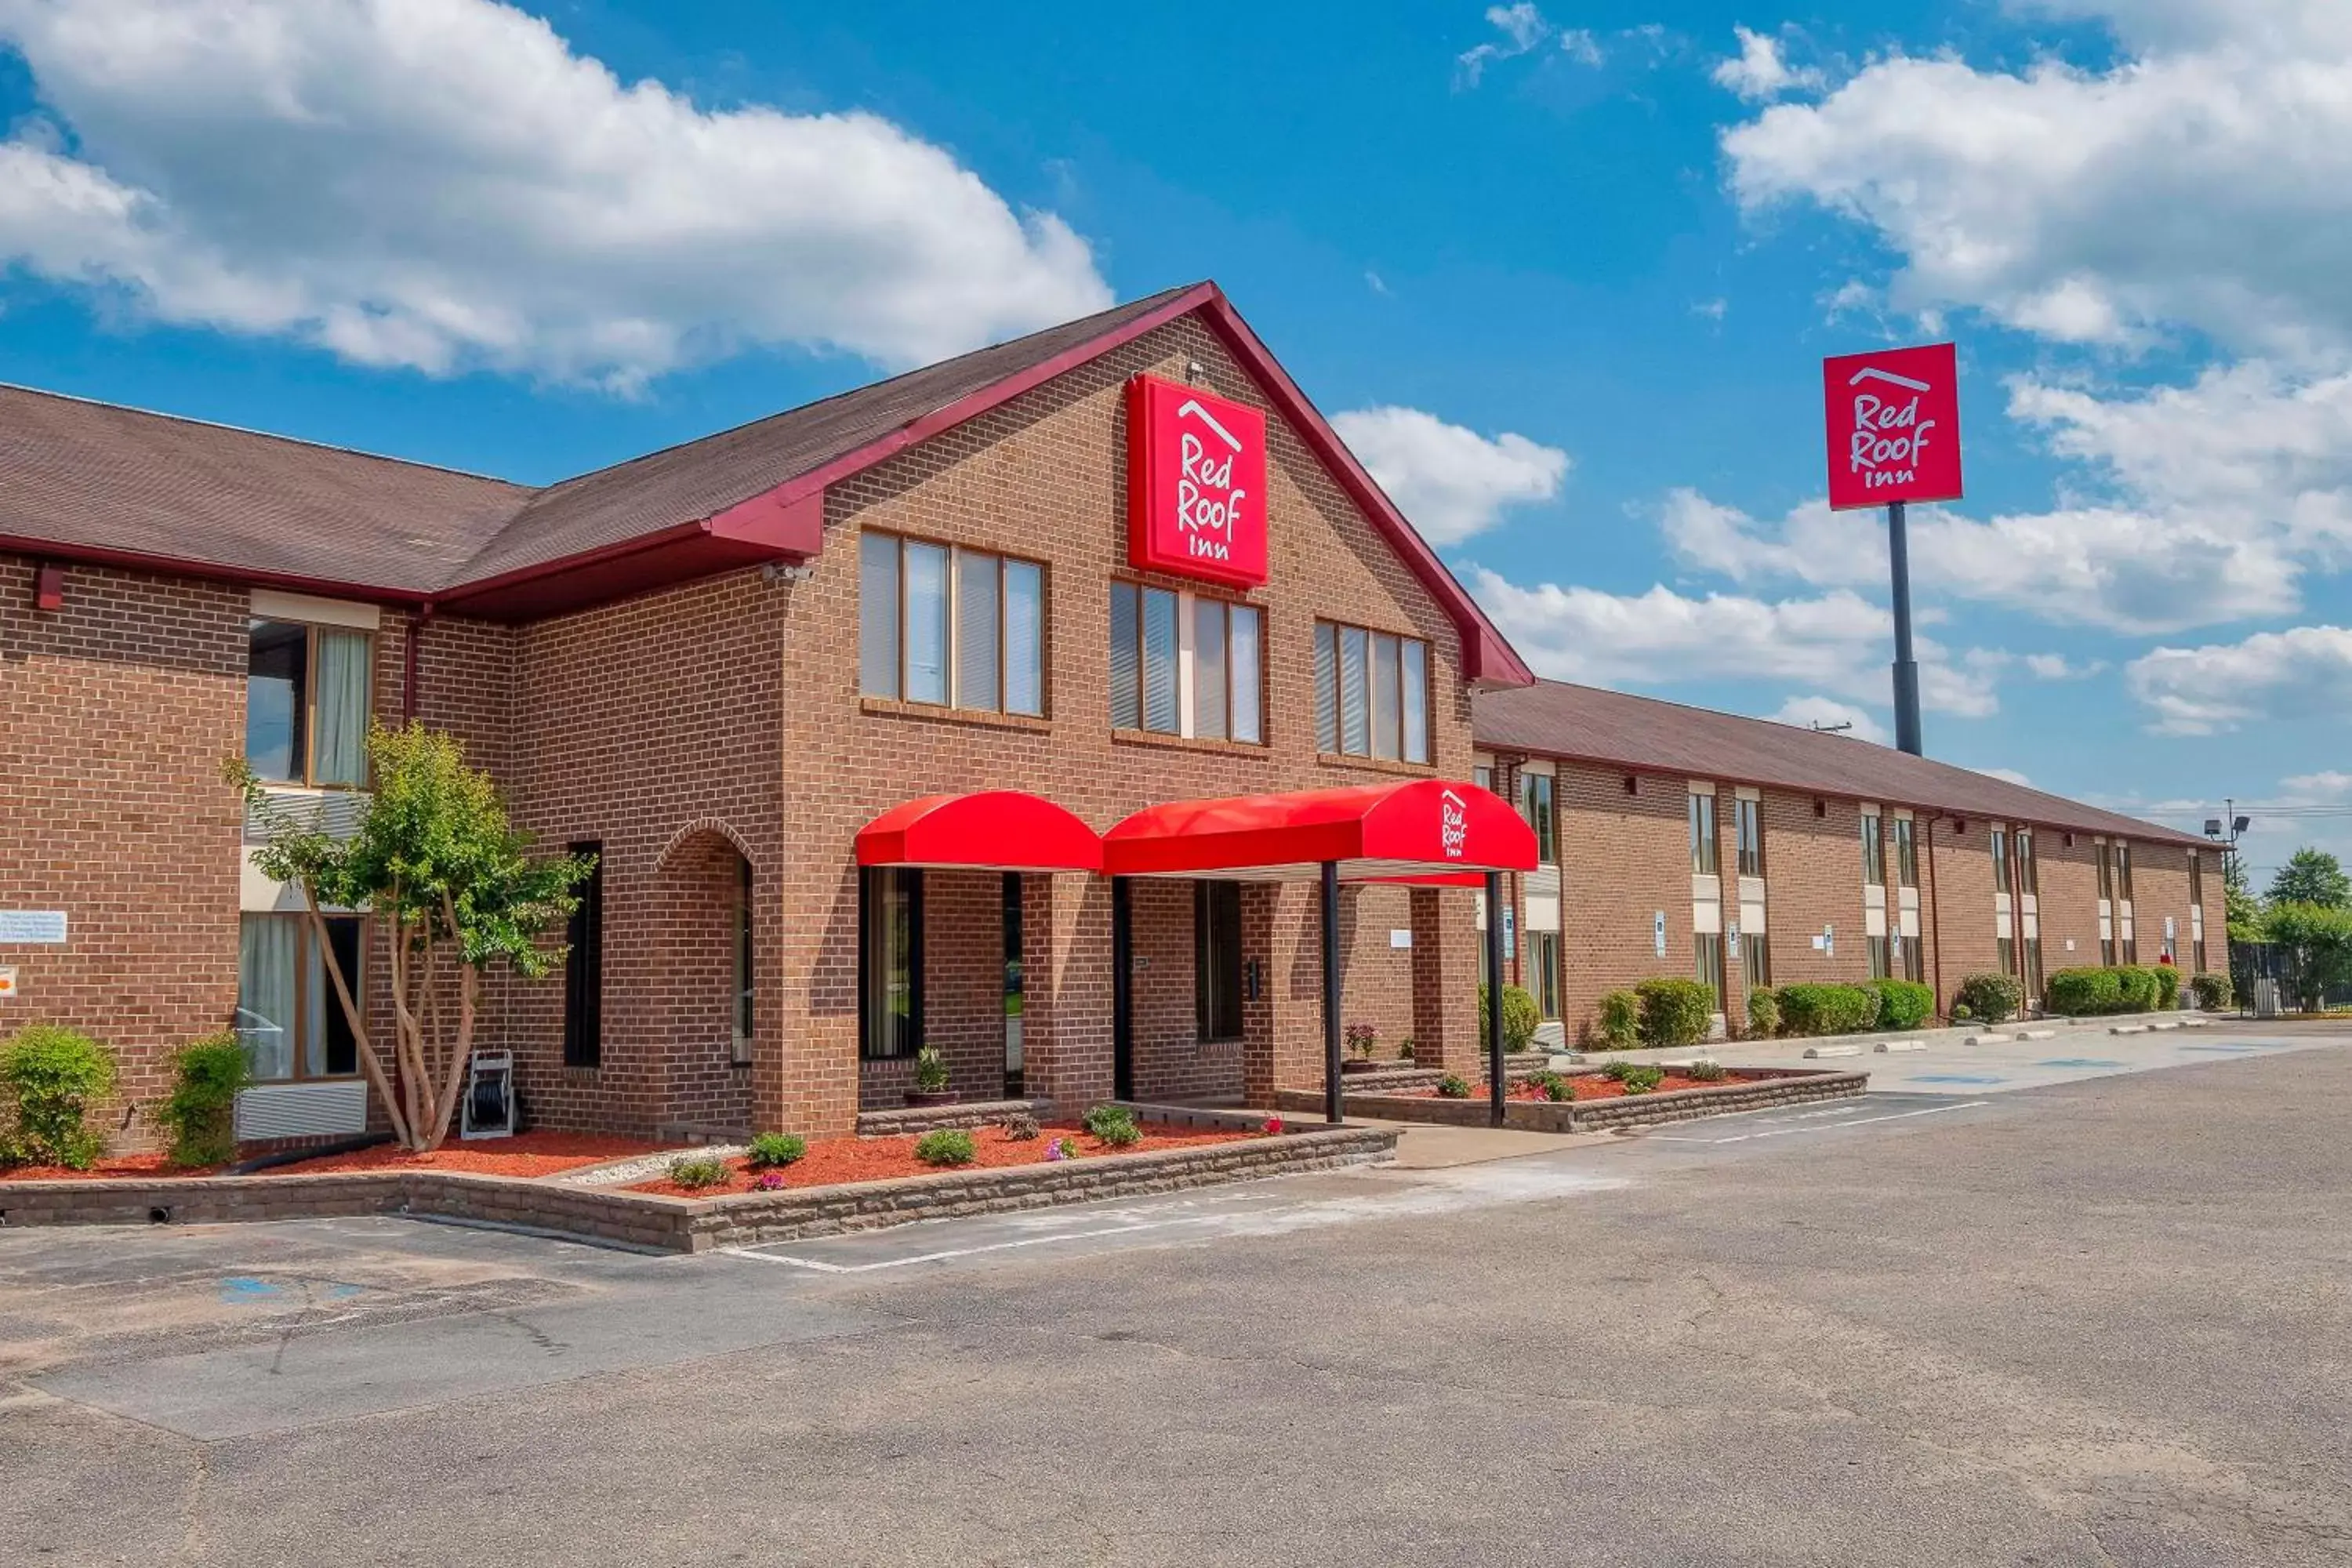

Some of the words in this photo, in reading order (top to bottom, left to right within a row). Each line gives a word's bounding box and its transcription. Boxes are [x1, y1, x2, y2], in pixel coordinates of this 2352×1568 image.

[1854, 394, 1918, 431] Red
[1181, 433, 1233, 489] Red
[1850, 419, 1935, 473] Roof
[1178, 479, 1246, 542] Roof
[1443, 804, 1464, 826] Red
[1443, 823, 1468, 848] Roof
